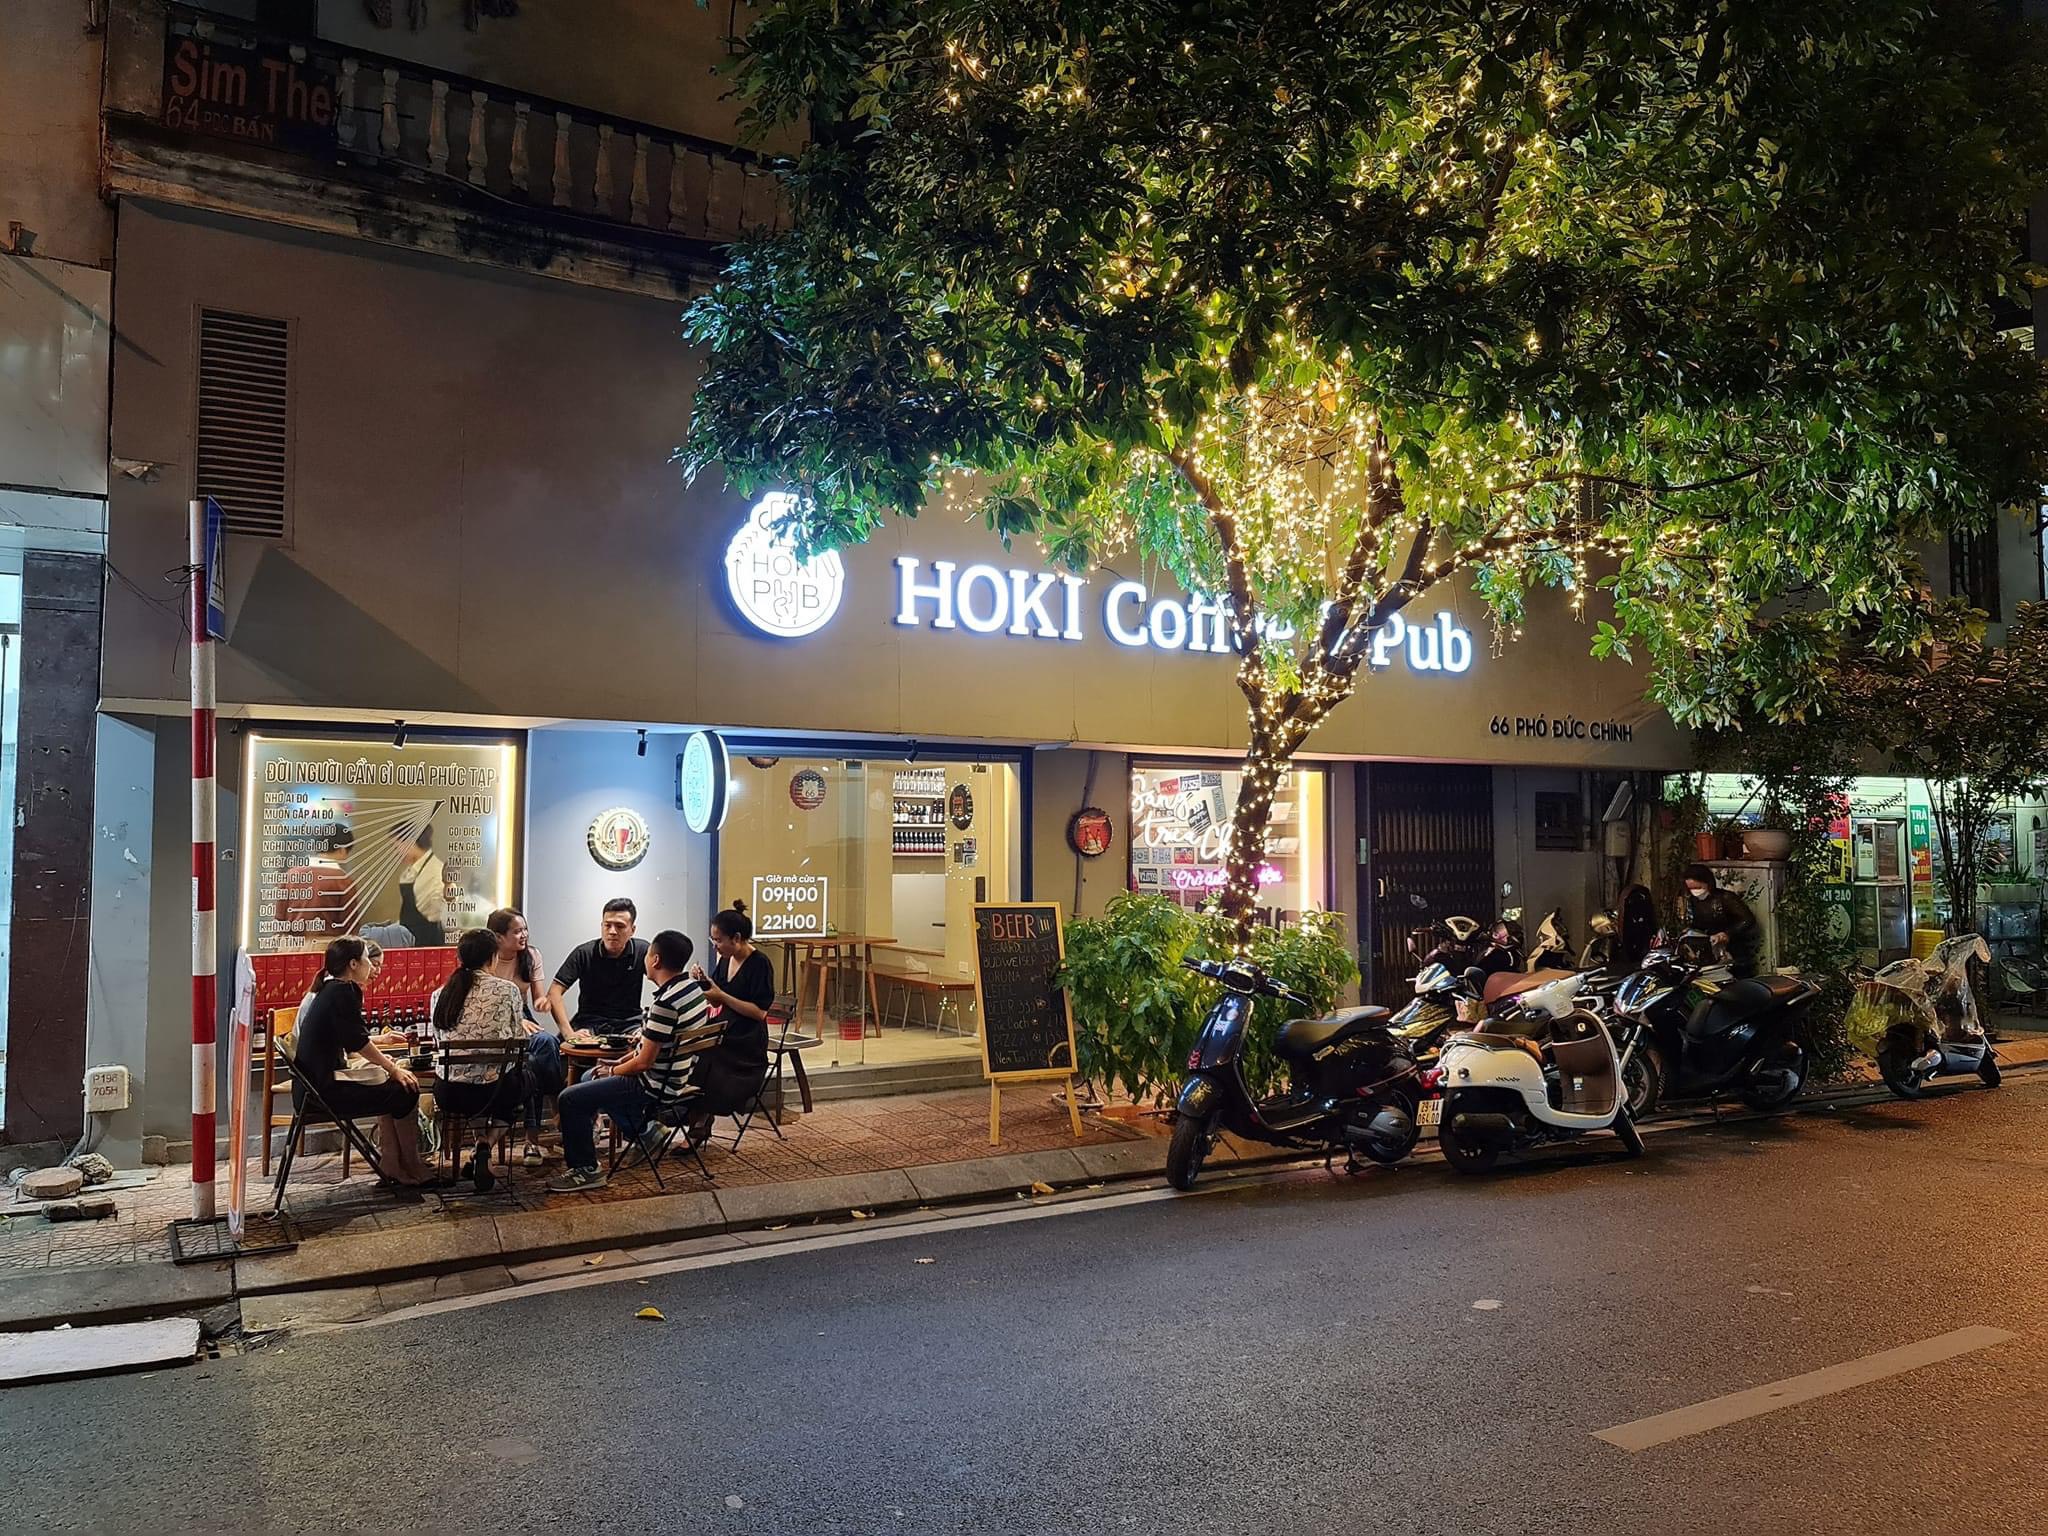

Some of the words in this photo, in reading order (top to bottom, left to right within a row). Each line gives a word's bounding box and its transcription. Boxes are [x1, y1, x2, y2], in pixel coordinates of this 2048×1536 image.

[171, 40, 247, 107] Sim
[166, 95, 200, 131] 64
[894, 556, 1084, 641] HOKI
[1368, 610, 1473, 674] Pub
[1489, 714, 1510, 736] 66
[1514, 712, 1548, 738] PHÓ
[1550, 713, 1586, 739] ĐỨC
[1587, 717, 1633, 742] CHÍNH
[265, 757, 292, 783] ĐỜI
[296, 758, 343, 784] NGƯỜI
[345, 757, 377, 785] CẦN
[379, 760, 394, 785] GÌ
[397, 762, 426, 787] QUÁ
[429, 762, 466, 787] PHỨC
[469, 767, 496, 791] TẠP
[448, 792, 493, 818] NHẬU
[766, 874, 782, 883] Giờ
[762, 887, 818, 902] 09H00
[762, 914, 817, 930] 22H00
[991, 913, 1038, 939] BEER
